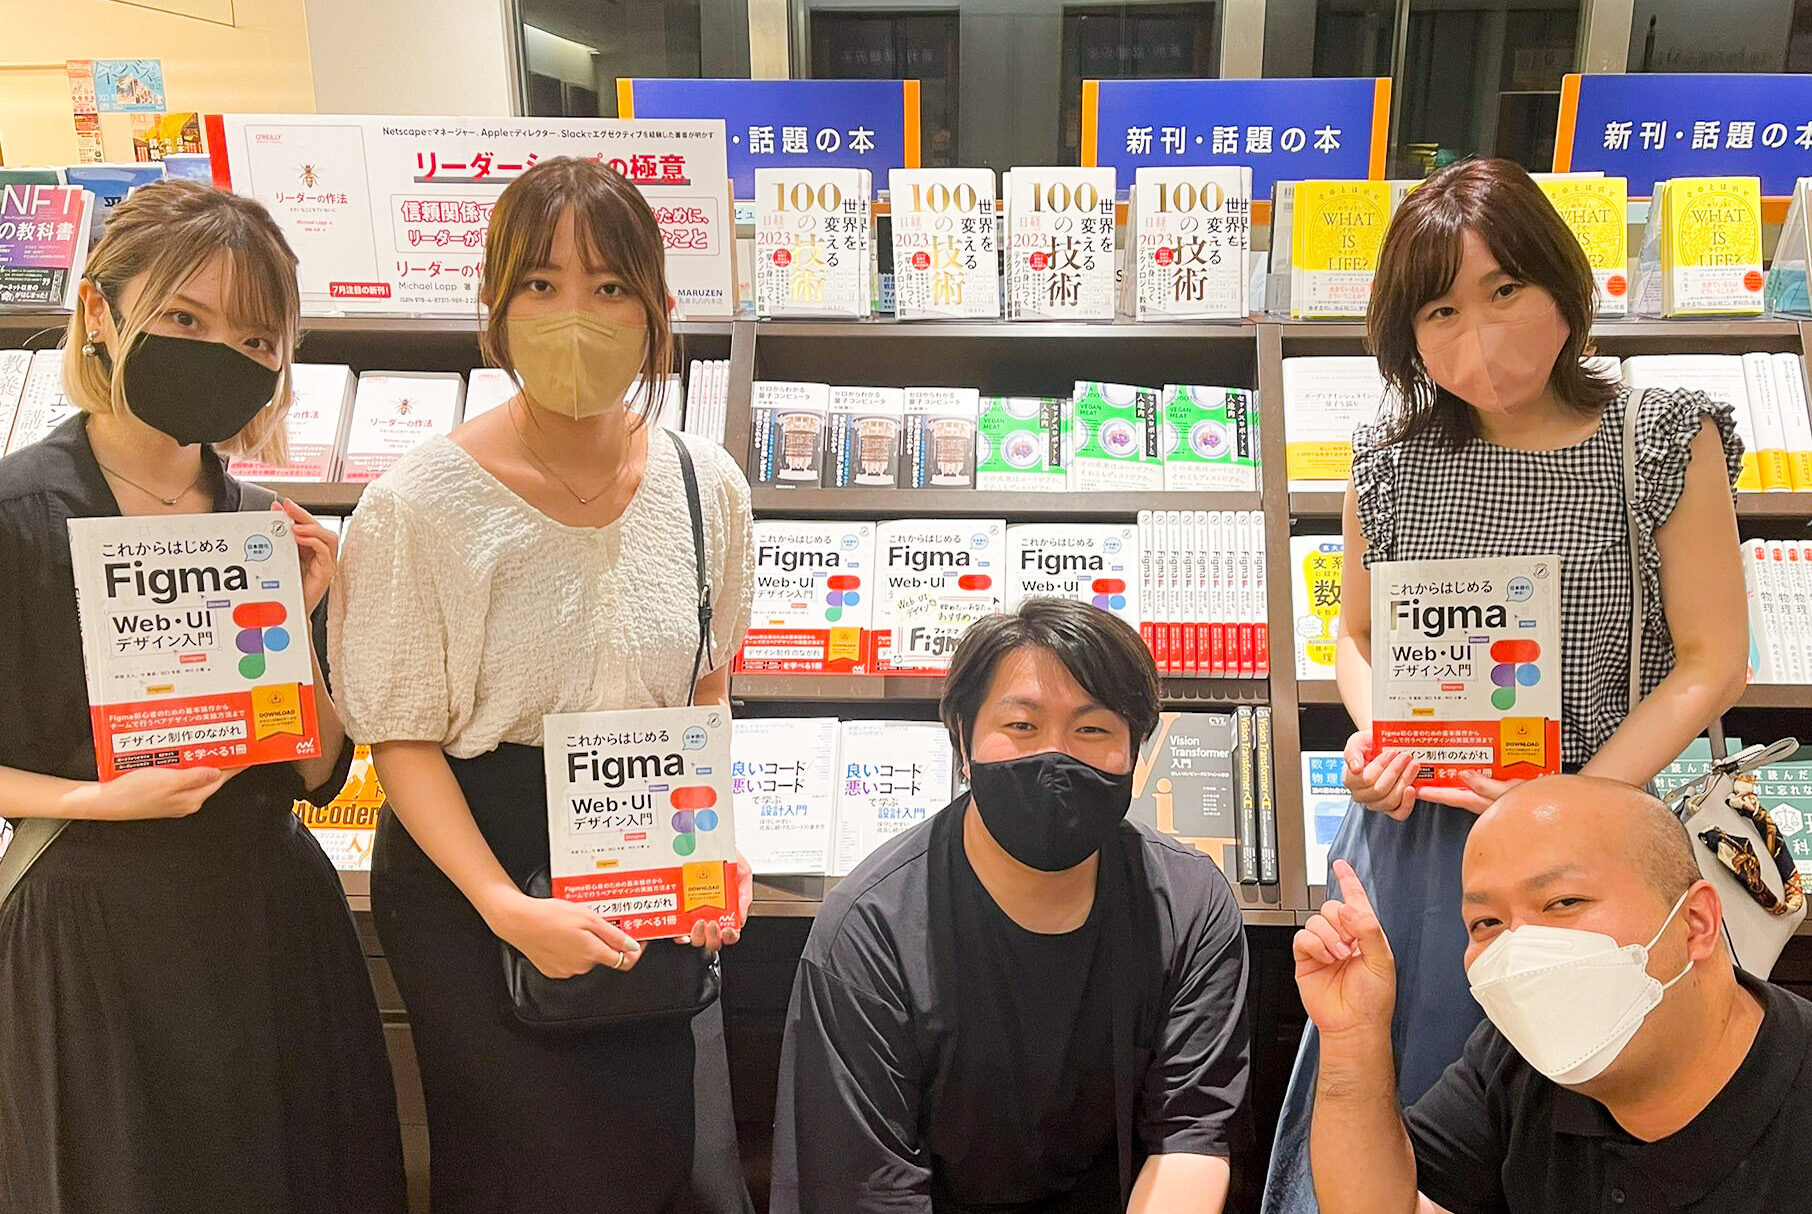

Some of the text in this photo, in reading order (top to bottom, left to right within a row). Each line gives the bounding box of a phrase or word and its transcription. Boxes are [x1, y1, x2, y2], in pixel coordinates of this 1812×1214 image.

[1126, 126, 1342, 154] 新刊・話題の本
[1, 184, 84, 215] NFT
[275, 192, 348, 205] リーダーの作法
[772, 182, 842, 213] 100
[907, 183, 977, 213] 100
[1028, 182, 1098, 213] 100
[1154, 181, 1224, 213] 100
[843, 198, 858, 250] 世界を
[1225, 197, 1240, 247] 世界を
[1323, 212, 1375, 226] WHAT
[1692, 209, 1746, 223] WHAT
[0, 221, 75, 241] の教科書
[978, 199, 993, 252] 世界を
[1099, 198, 1114, 253] 世界を
[757, 232, 791, 246] 2023
[825, 217, 840, 267] 変える
[895, 233, 929, 248] 2023
[961, 217, 977, 270] 変える
[1014, 233, 1047, 248] 2023
[1081, 217, 1096, 270] 変える
[1139, 234, 1173, 246] 2023
[1208, 217, 1223, 265] 変える
[1342, 234, 1356, 248] IS
[1712, 231, 1726, 245] IS
[1328, 257, 1368, 271] LIFE?
[1699, 254, 1741, 267] LIFE?
[399, 282, 432, 290] Michael
[434, 282, 457, 291] Lopp
[371, 418, 433, 428] リーダーの作法
[760, 535, 832, 544] これからはじめる
[890, 534, 961, 544] これからはじめる
[1021, 538, 1094, 547] これからはじめる
[102, 538, 229, 558] これからはじめる
[758, 545, 840, 572] Figma
[888, 546, 970, 572] Figma
[1021, 549, 1103, 575] Figma
[104, 560, 248, 605] Figma
[1390, 580, 1493, 596] これからはじめる
[757, 590, 813, 599] デザイン入門
[1391, 599, 1506, 638] Figma
[116, 632, 213, 652] デザイン入門
[1393, 664, 1472, 677] デザイン入門
[259, 709, 295, 718] DOWNLOAD
[118, 726, 242, 748] デザイン制作のながれ
[1240, 716, 1250, 741] Vision
[1257, 717, 1268, 742] Vision
[566, 730, 670, 747] これからはじめる
[1169, 735, 1199, 746] Vision
[184, 743, 247, 762] を学べる1冊
[1170, 747, 1229, 758] Transformer
[1408, 750, 1488, 760] イン制作のながれ
[567, 750, 684, 788] Figma
[731, 760, 806, 777] 良いコード
[845, 762, 923, 780] 良いコード
[1170, 759, 1191, 769] 入門
[1311, 758, 1337, 770] 数学
[732, 777, 805, 795] 悪いコード
[1311, 773, 1337, 784] 物理
[845, 779, 921, 797] 悪いコード
[760, 804, 808, 817] 設計入門
[878, 806, 926, 819] 設計入門
[574, 813, 653, 830] デザイン入門
[590, 898, 673, 914] イン制作のながれ
[624, 915, 677, 930] を学べる1冊
